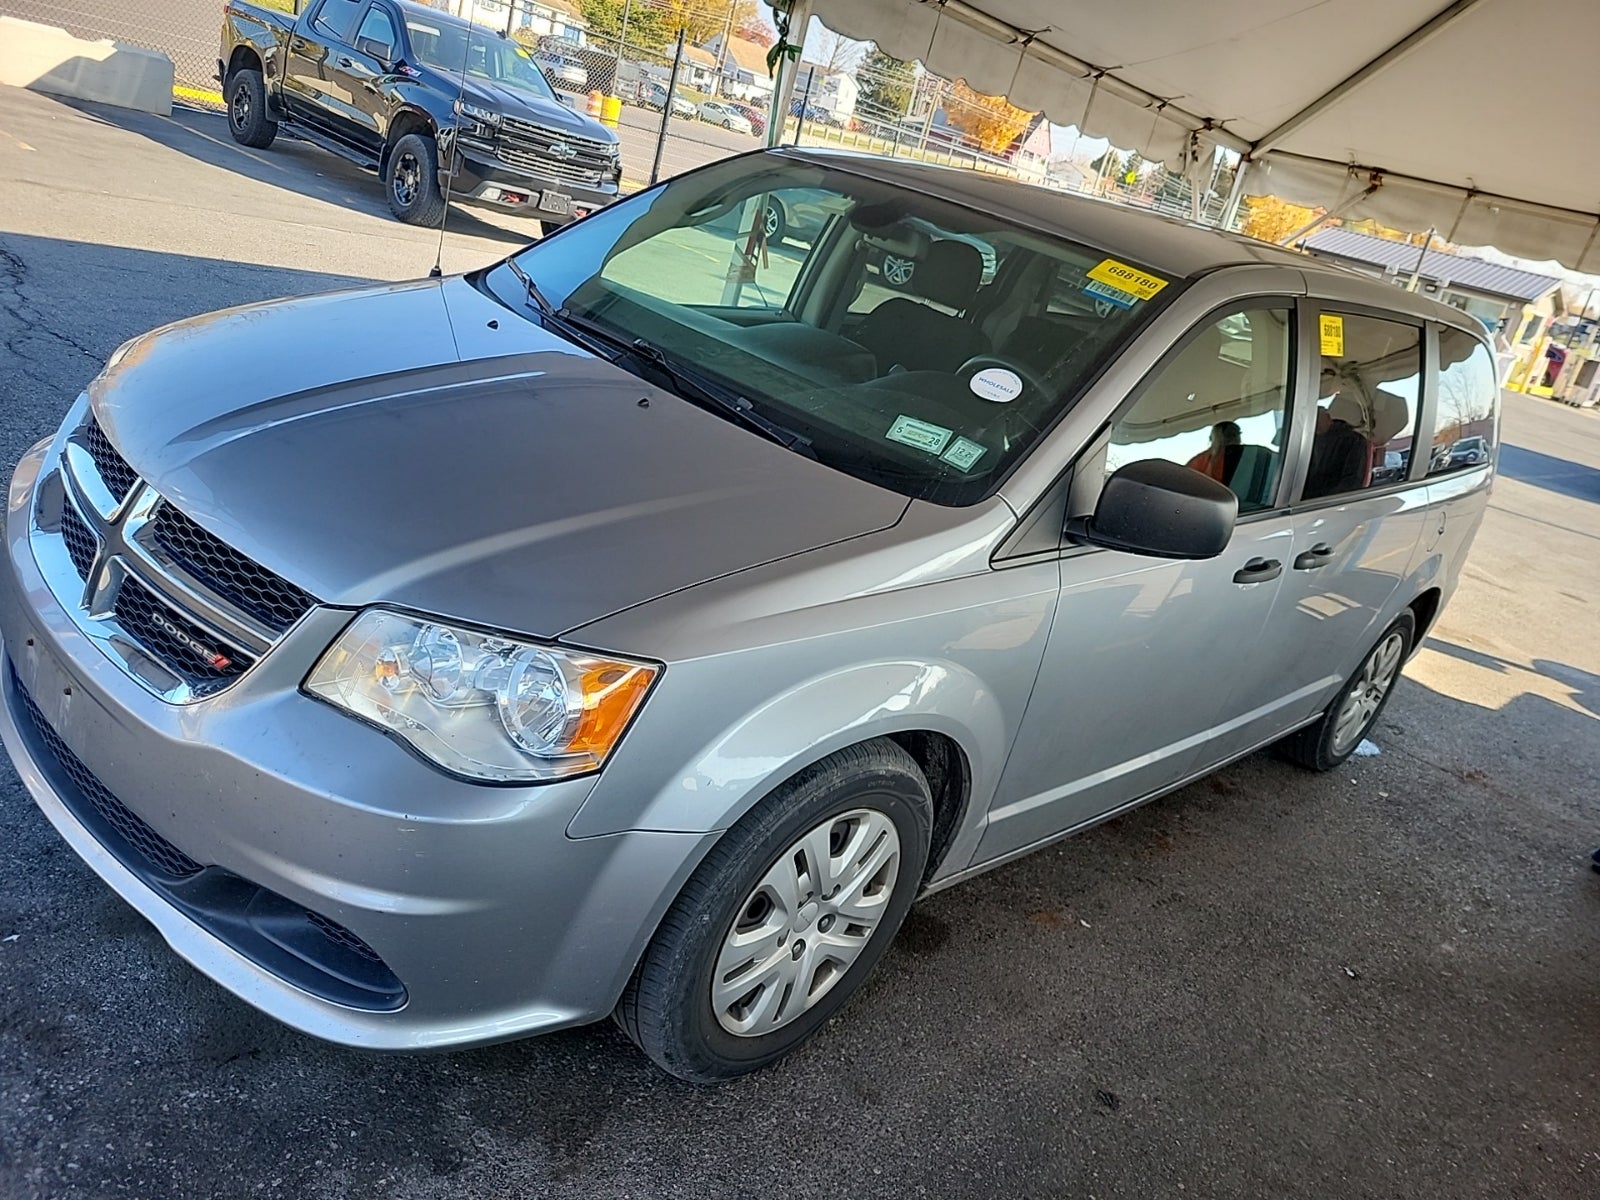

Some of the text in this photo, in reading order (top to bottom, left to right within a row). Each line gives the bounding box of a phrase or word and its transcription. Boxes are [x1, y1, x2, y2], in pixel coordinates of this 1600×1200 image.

[1108, 266, 1158, 289] 688180
[979, 377, 1014, 394] WHOLESALE
[896, 426, 904, 434] 5
[928, 437, 940, 446] 28
[152, 613, 217, 664] DODGE
